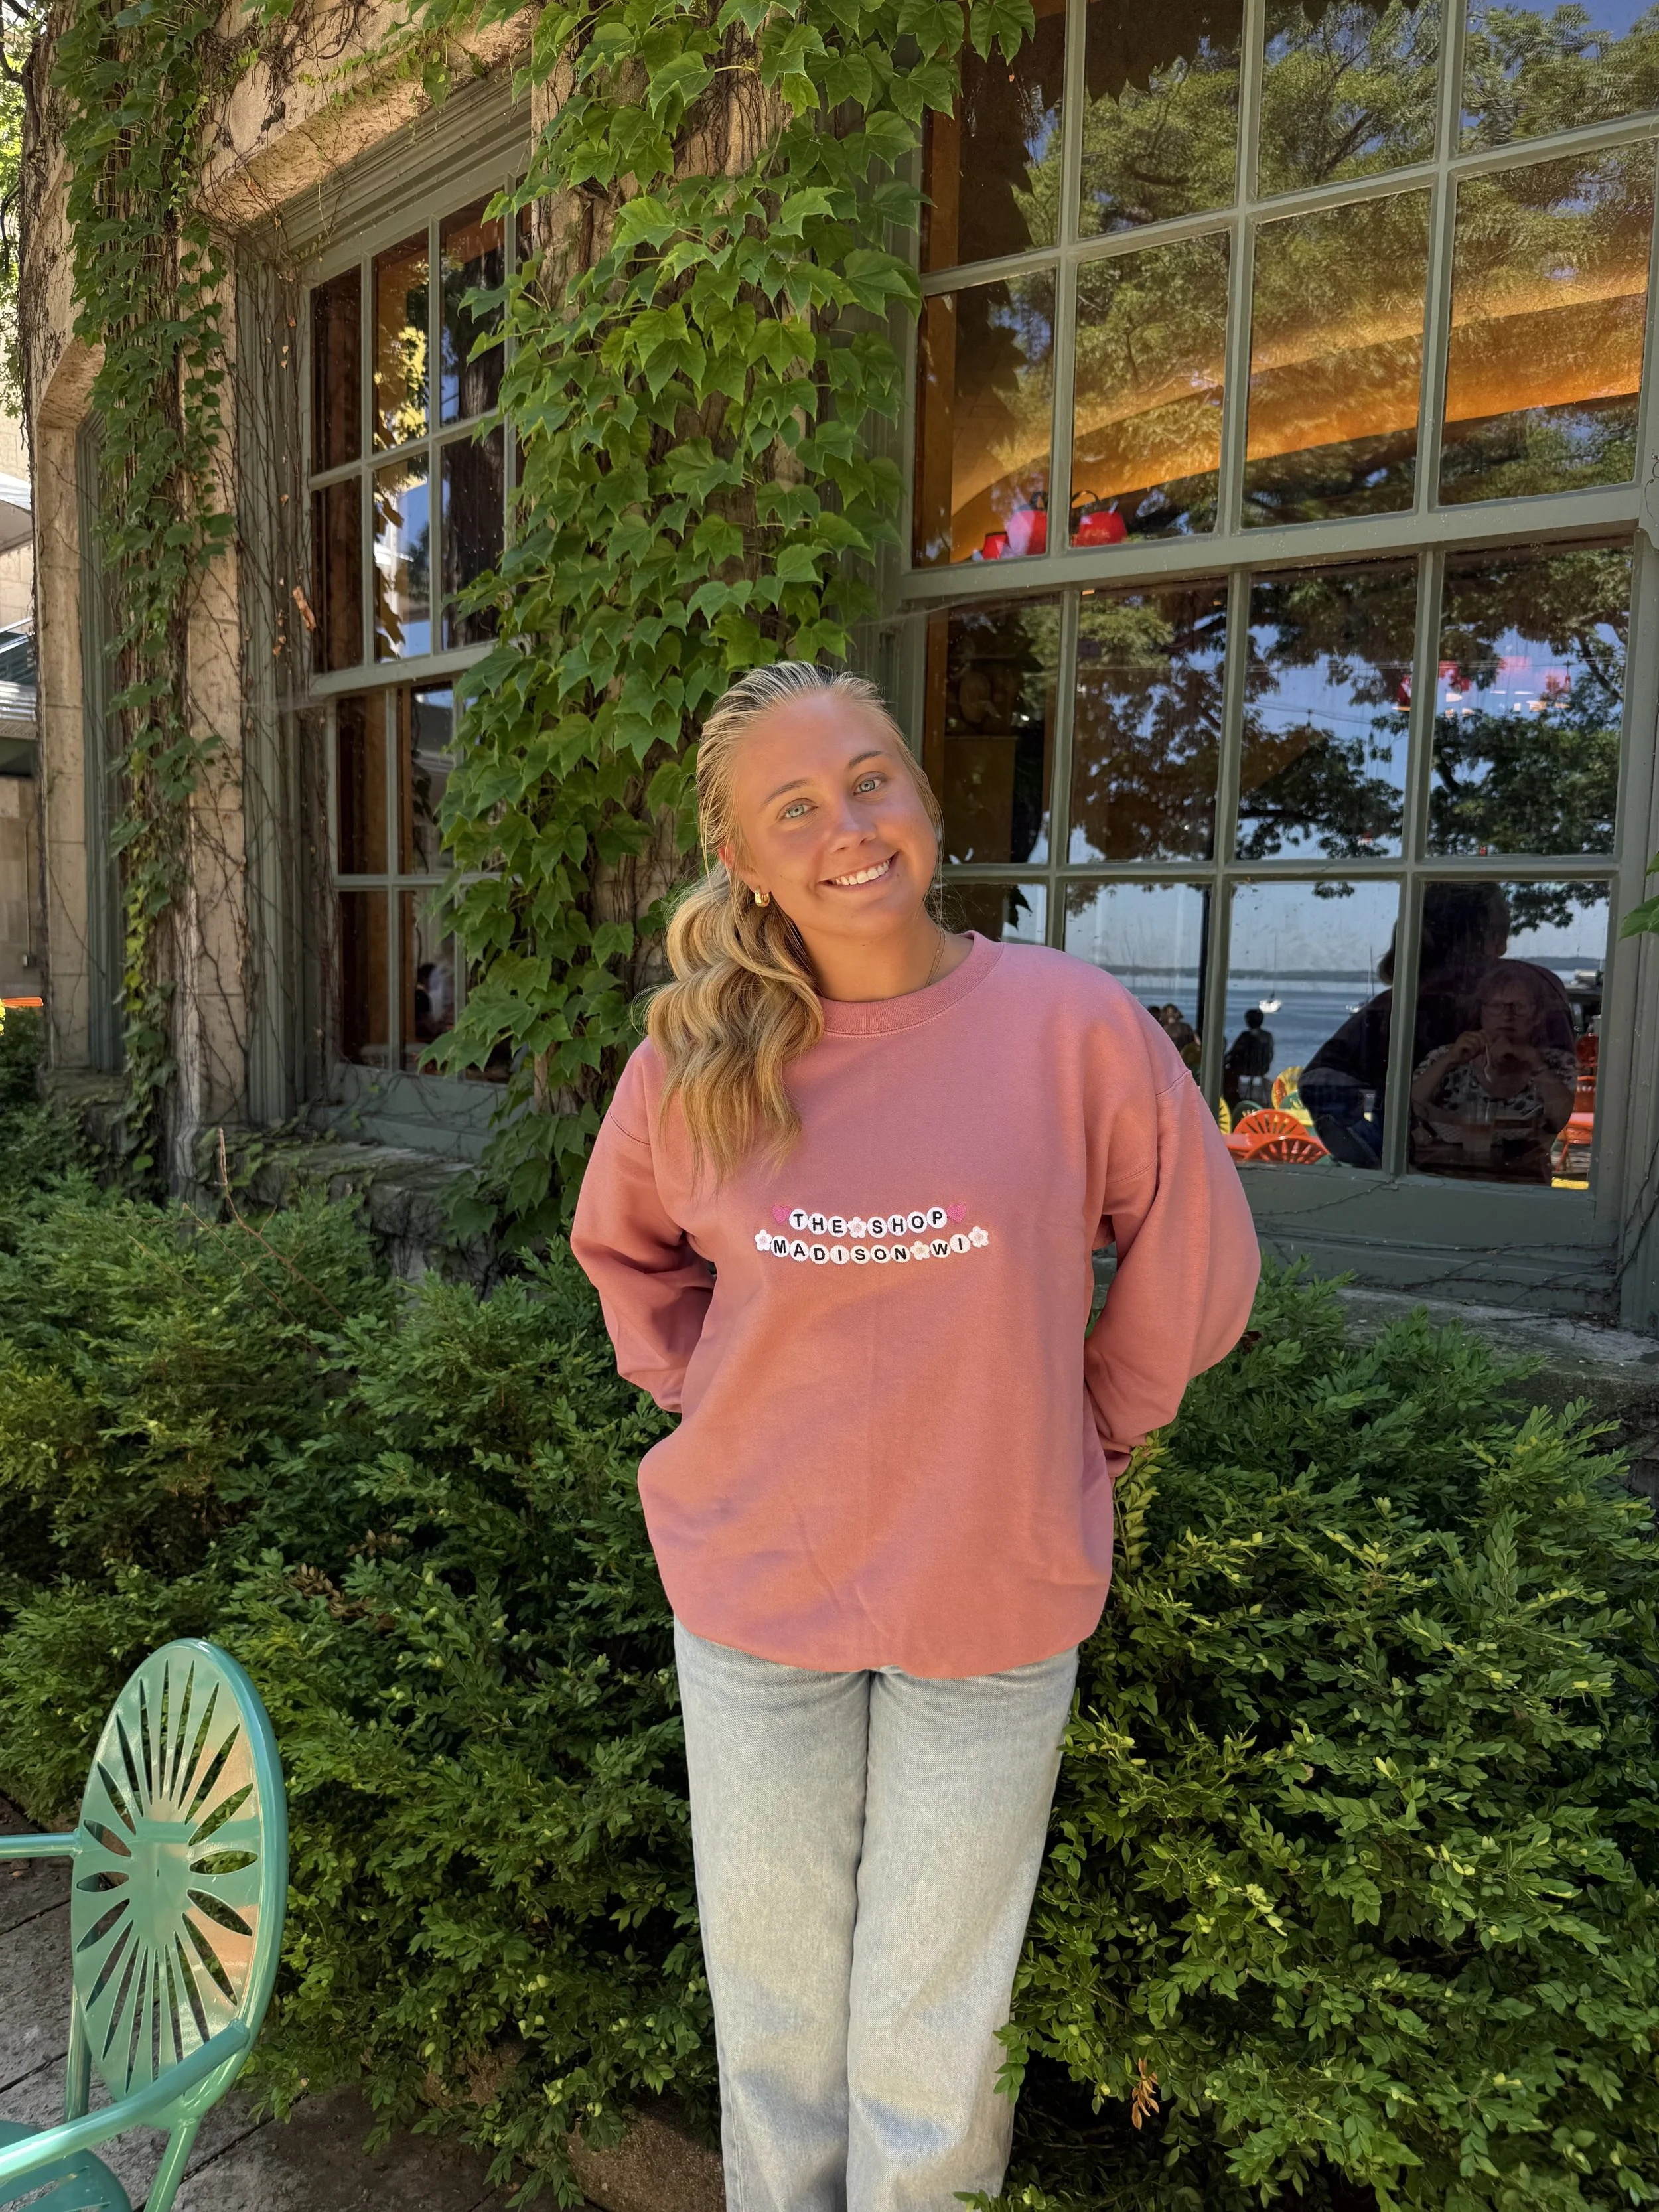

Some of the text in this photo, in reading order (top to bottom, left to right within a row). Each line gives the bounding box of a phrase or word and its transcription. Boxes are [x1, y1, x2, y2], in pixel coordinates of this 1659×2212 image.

[792, 1209, 944, 1234] THE SHOP
[773, 1236, 964, 1262] MADISON WI
